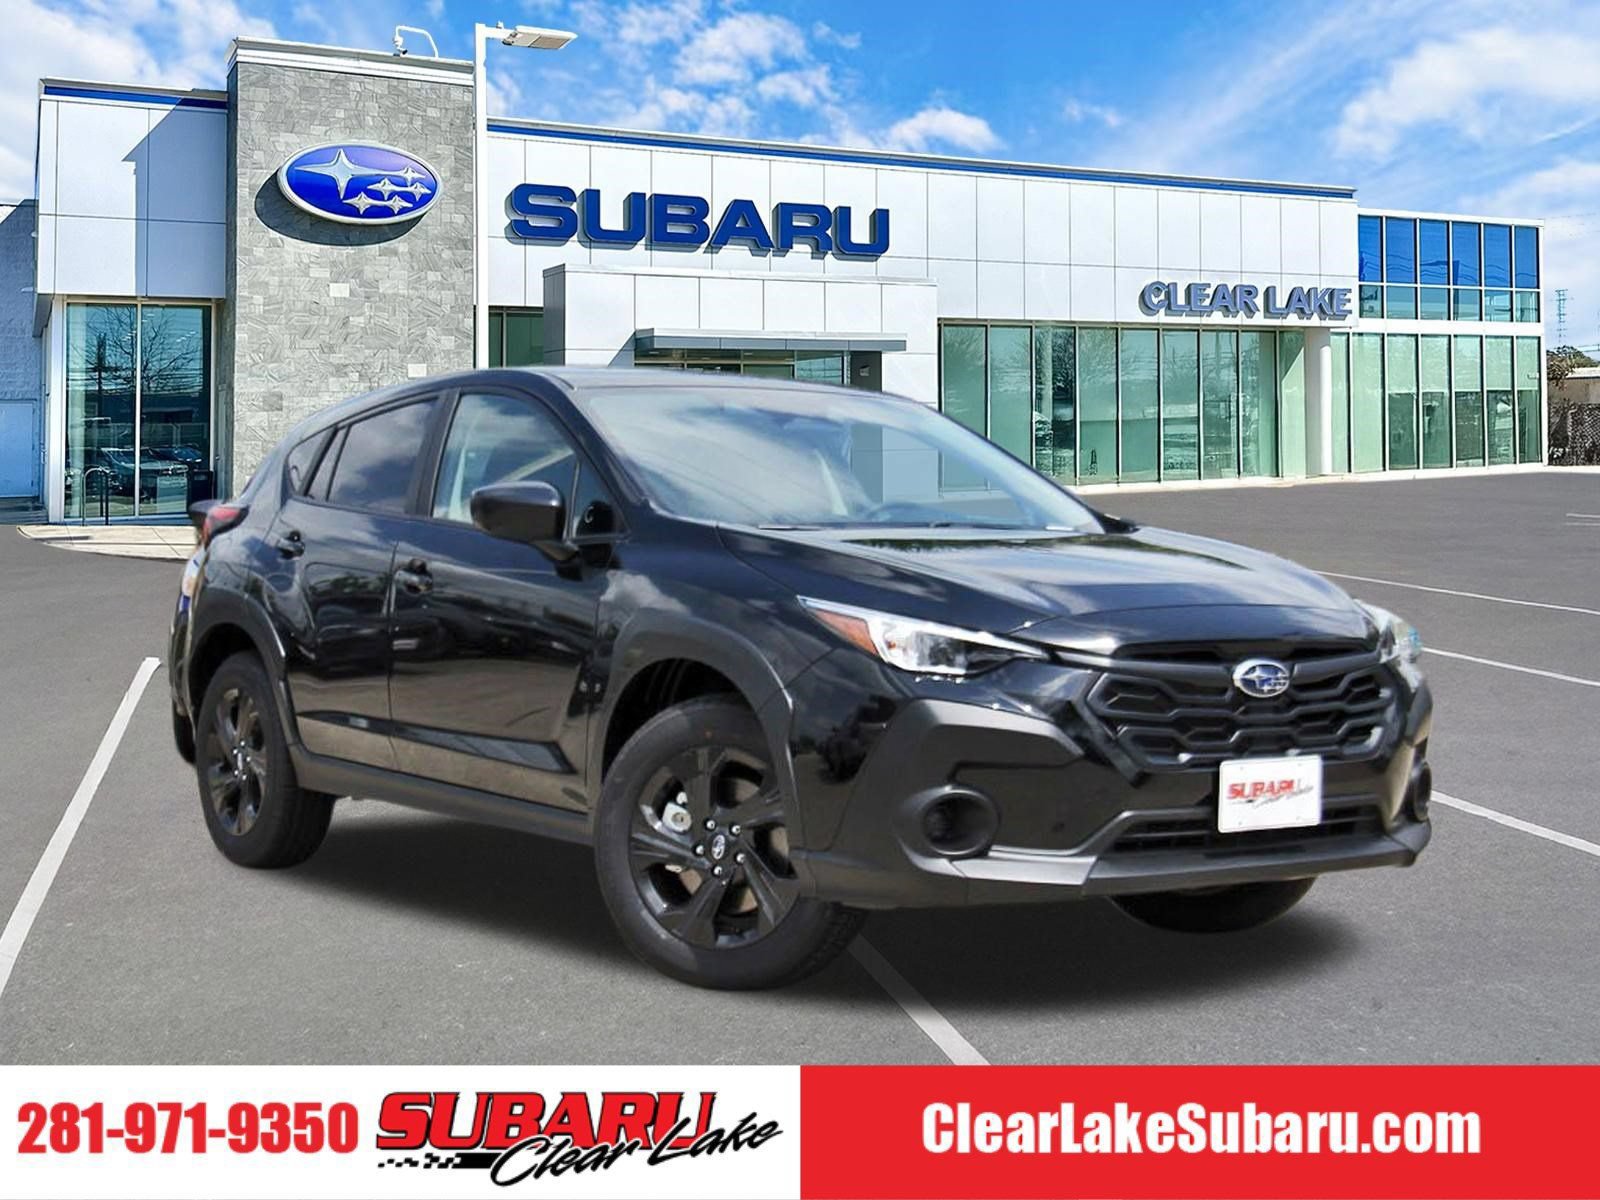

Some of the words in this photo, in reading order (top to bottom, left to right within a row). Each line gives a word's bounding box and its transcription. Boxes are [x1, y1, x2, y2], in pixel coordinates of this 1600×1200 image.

[506, 183, 890, 260] SUBARU
[1140, 281, 1260, 317] CLEAR
[1264, 286, 1352, 319] LAKE
